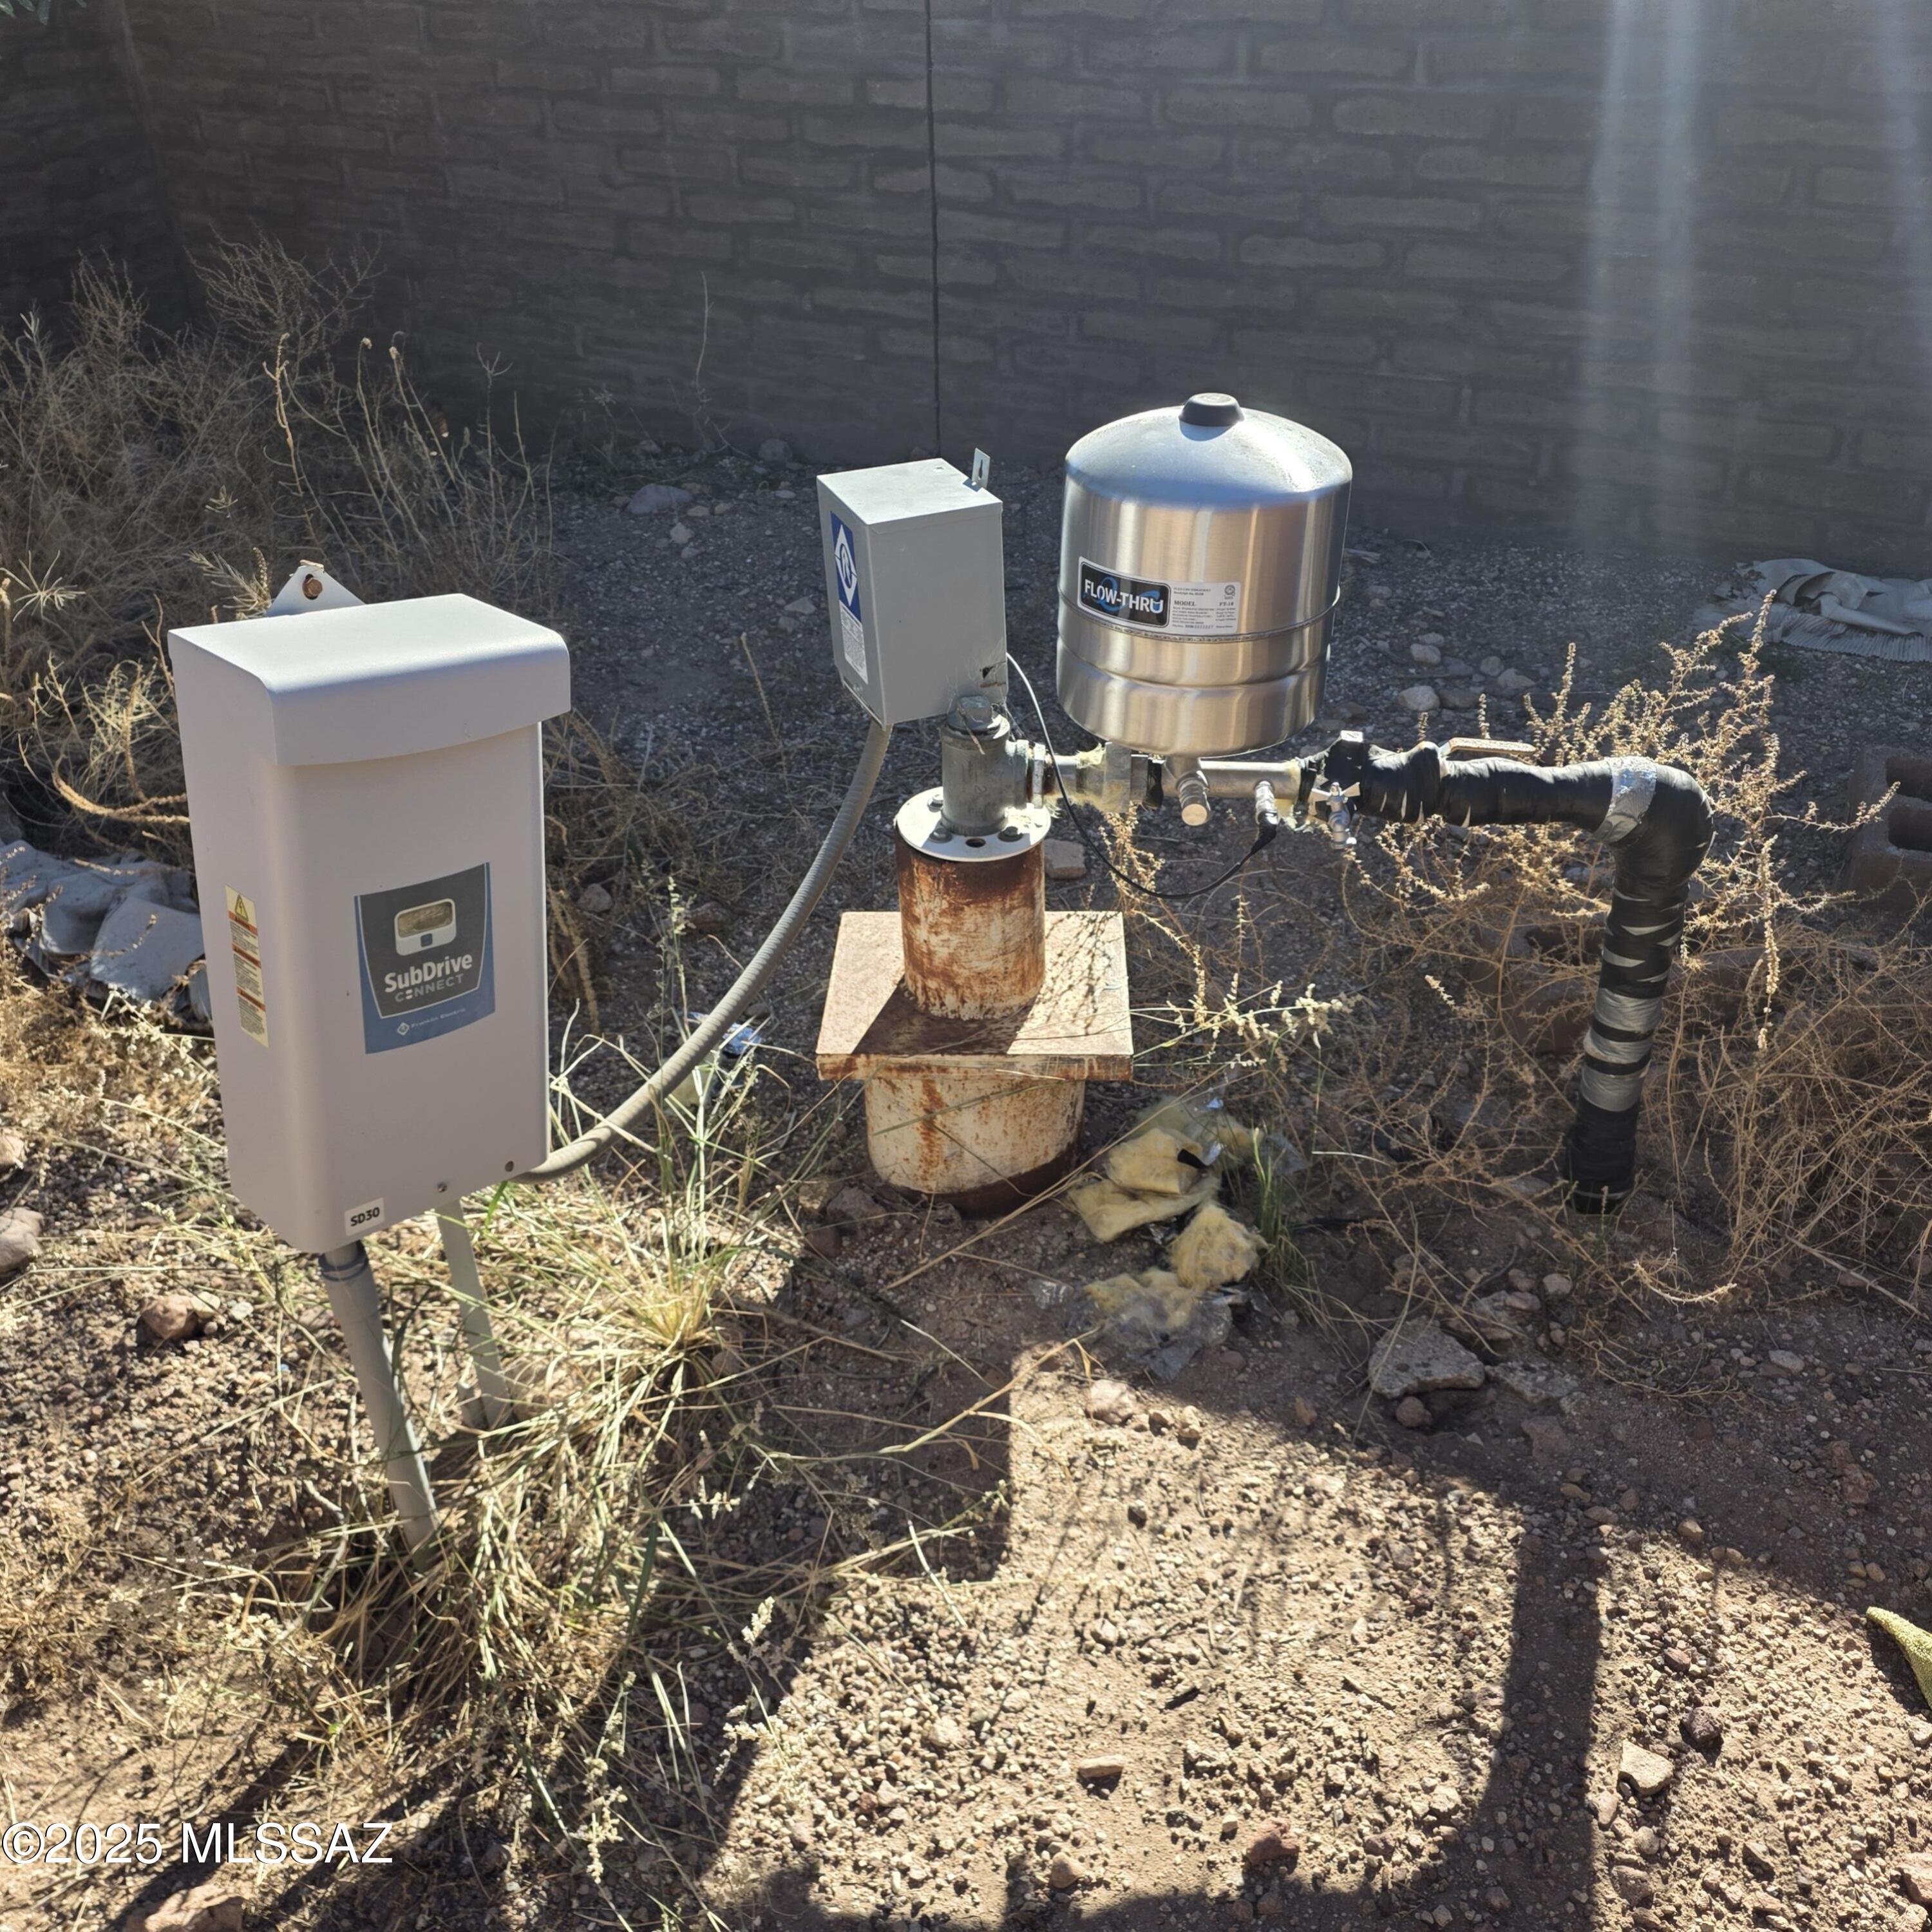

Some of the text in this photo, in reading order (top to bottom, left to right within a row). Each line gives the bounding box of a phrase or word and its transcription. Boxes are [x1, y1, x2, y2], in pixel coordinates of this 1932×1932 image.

[1084, 579, 1164, 614] FLOW-THRU
[384, 954, 473, 993] SubDrive
[350, 1206, 380, 1227] SD30
